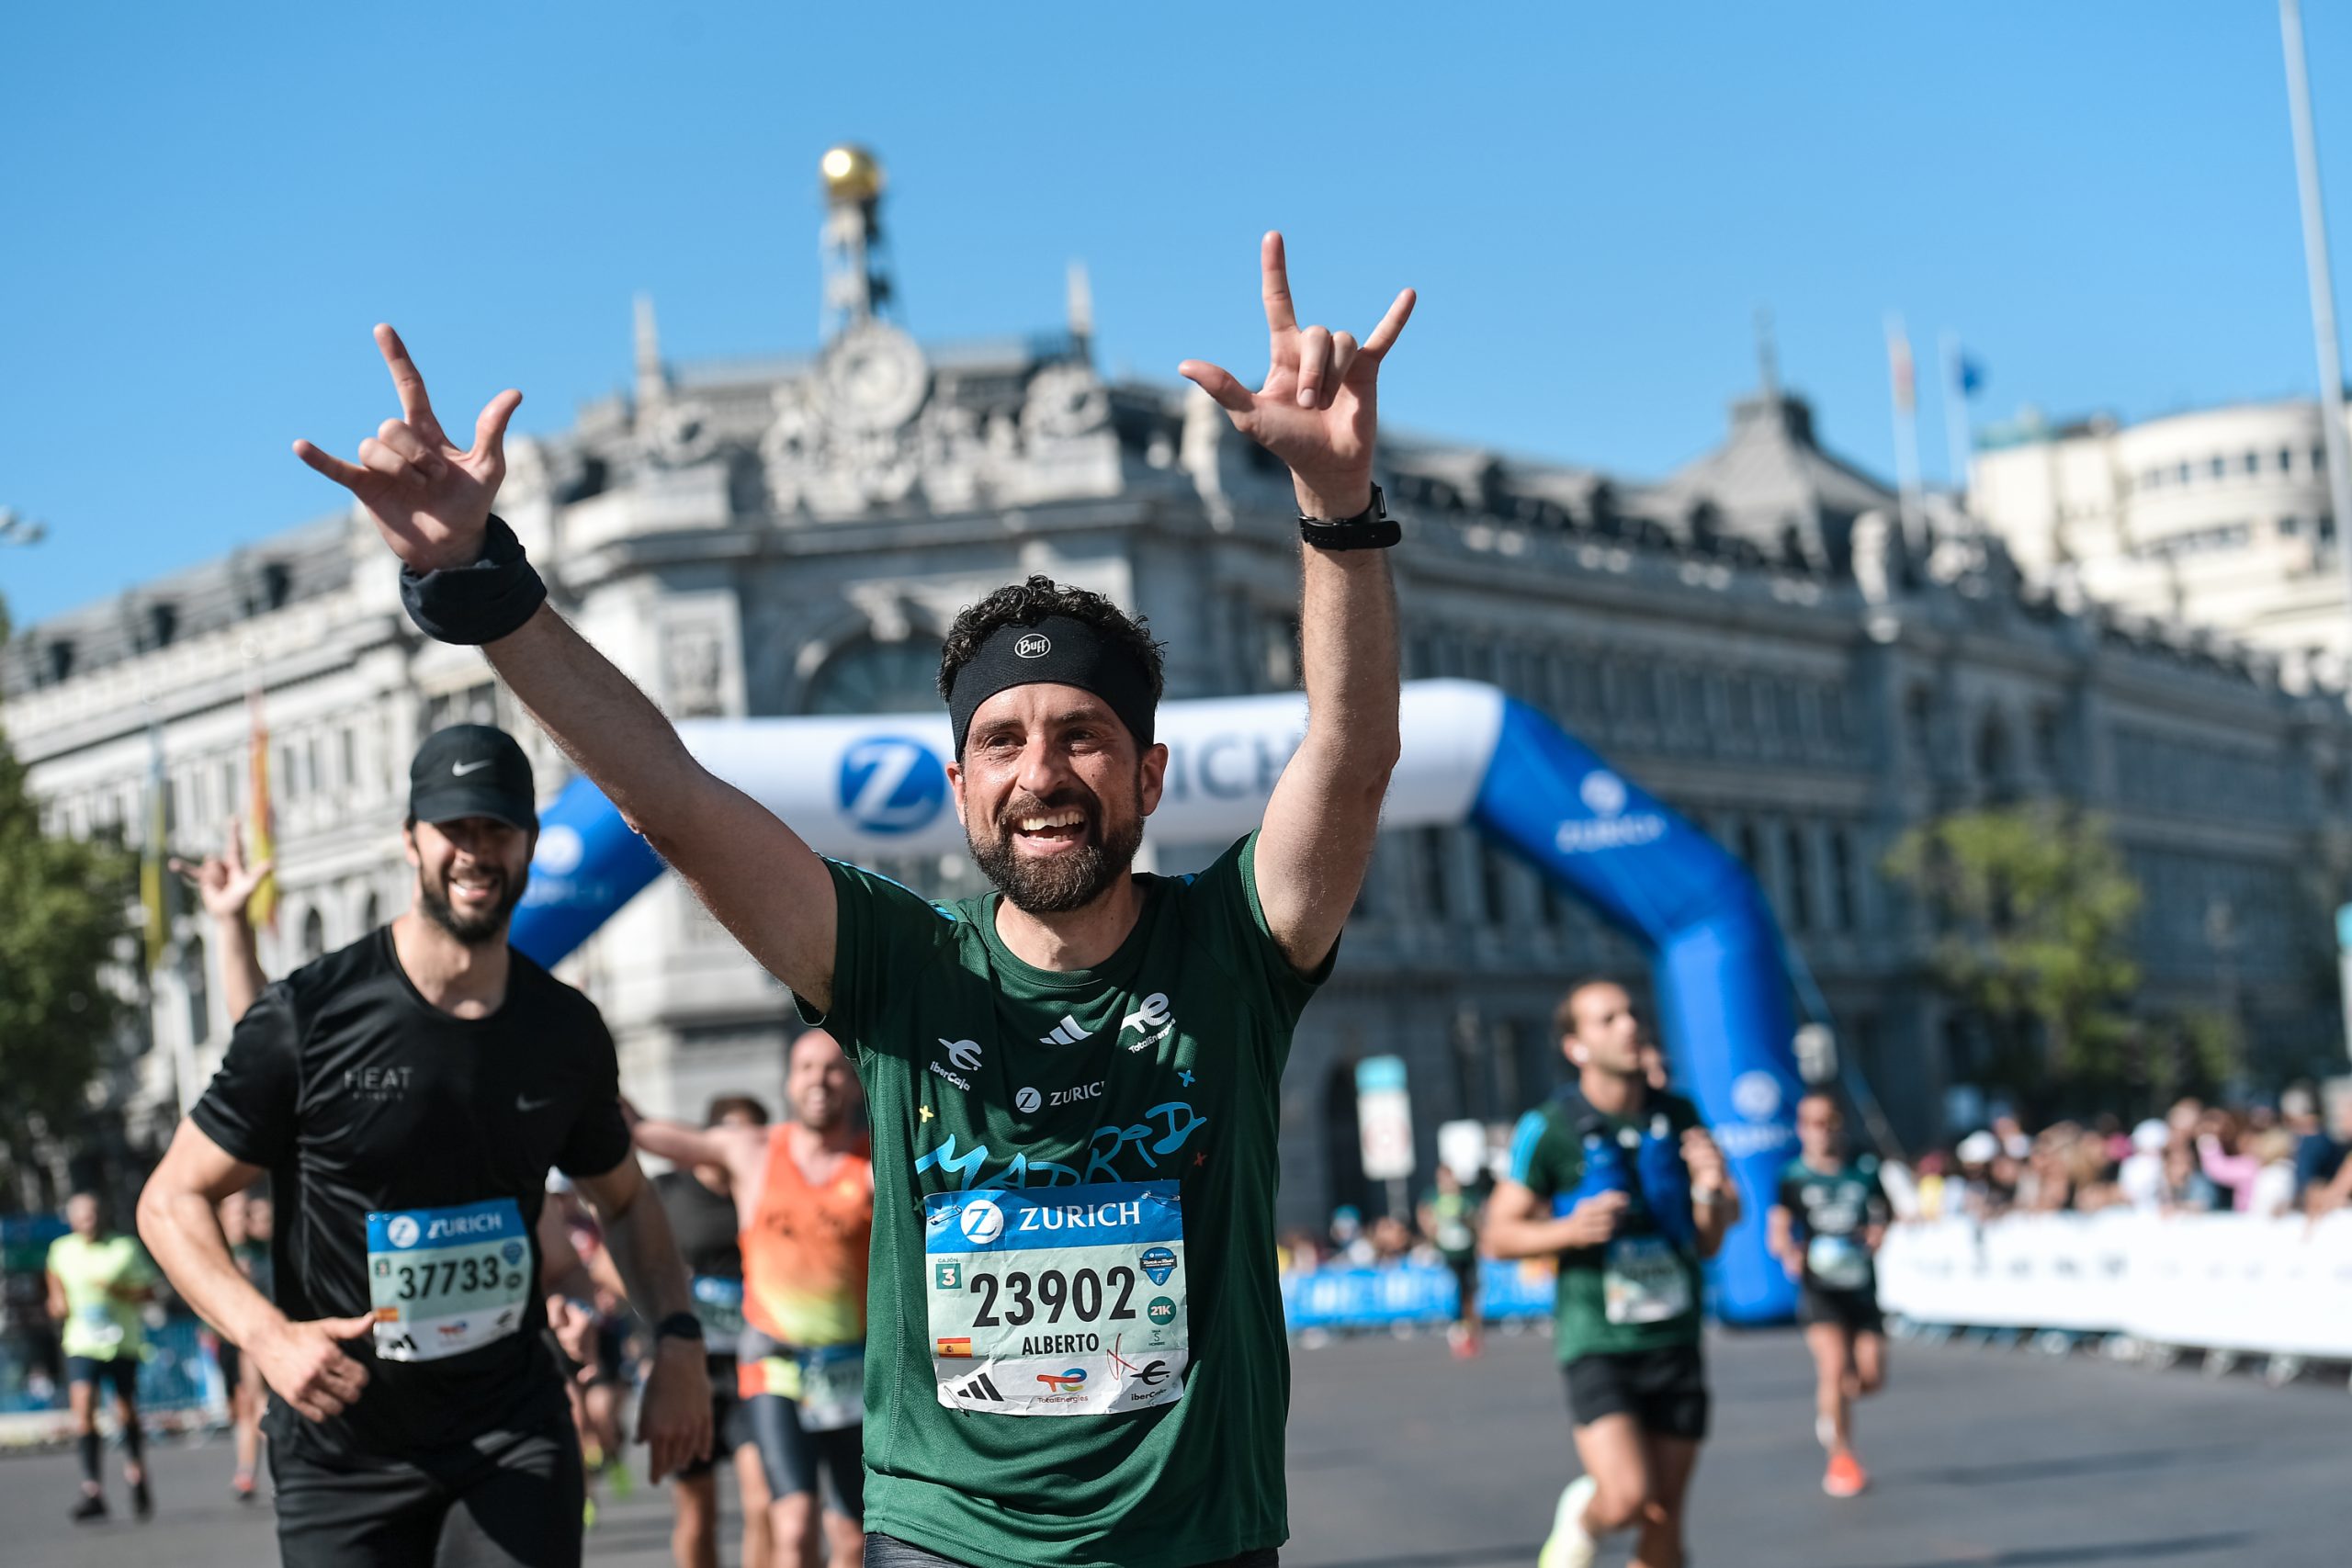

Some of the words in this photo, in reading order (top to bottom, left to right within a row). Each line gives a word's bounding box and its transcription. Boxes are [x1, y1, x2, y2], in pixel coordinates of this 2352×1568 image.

[1020, 639, 1046, 655] Buff
[344, 1066, 412, 1089] HEAT
[1049, 1081, 1104, 1106] ZURIC
[427, 1213, 503, 1239] ZURICH
[1019, 1201, 1141, 1231] ZURICH
[398, 1255, 500, 1300] 37733
[942, 1268, 956, 1286] 3
[970, 1266, 1136, 1328] 23902
[1150, 1304, 1171, 1316] 21K
[1022, 1333, 1100, 1356] ALBERTO
[1037, 1395, 1089, 1404] TotalEnergies
